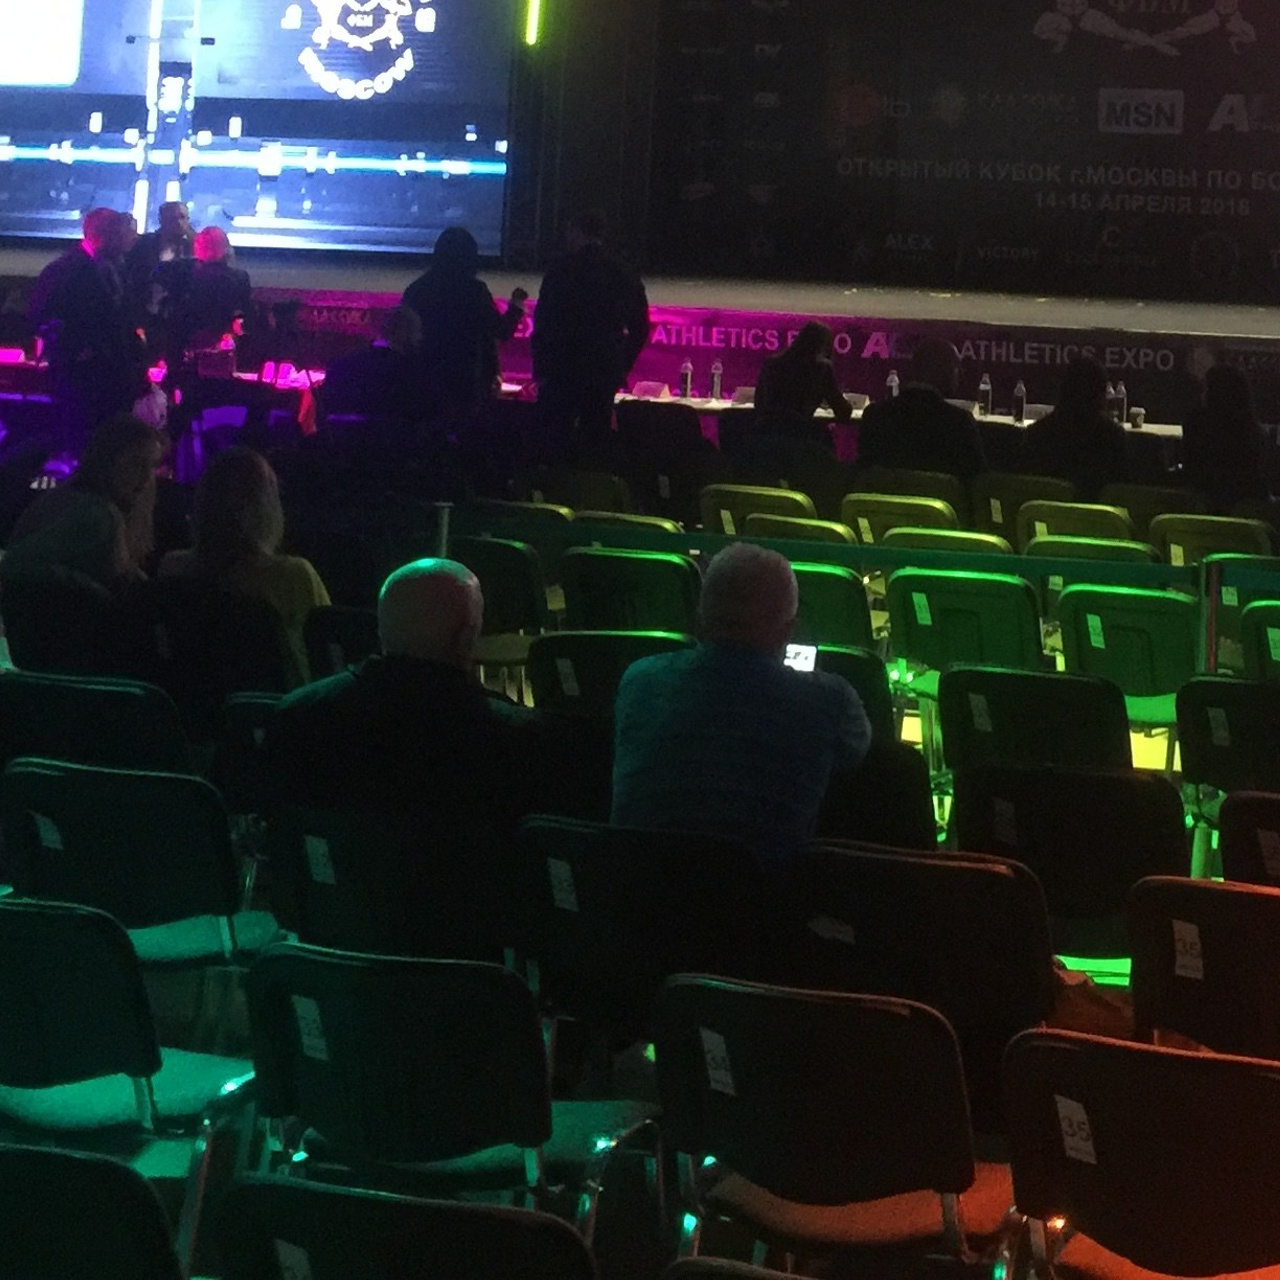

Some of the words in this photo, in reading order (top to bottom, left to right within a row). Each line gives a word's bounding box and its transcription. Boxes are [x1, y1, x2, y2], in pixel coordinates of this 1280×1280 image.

[1106, 100, 1177, 128] MSN
[837, 156, 971, 180] ОТКРЫТЫЙ
[979, 161, 1062, 184] КУБОК
[1069, 166, 1198, 189] г.МОСКВЫ
[1206, 170, 1243, 190] ПО
[1034, 190, 1093, 209] 14-15
[1099, 195, 1193, 214] АПРЕЛЯ
[1200, 197, 1250, 216] 2018
[885, 233, 934, 251] ALEX
[651, 324, 780, 350] ATHLETICS
[960, 339, 1097, 365] ATHLETICS
[1105, 347, 1175, 371] EXPO
